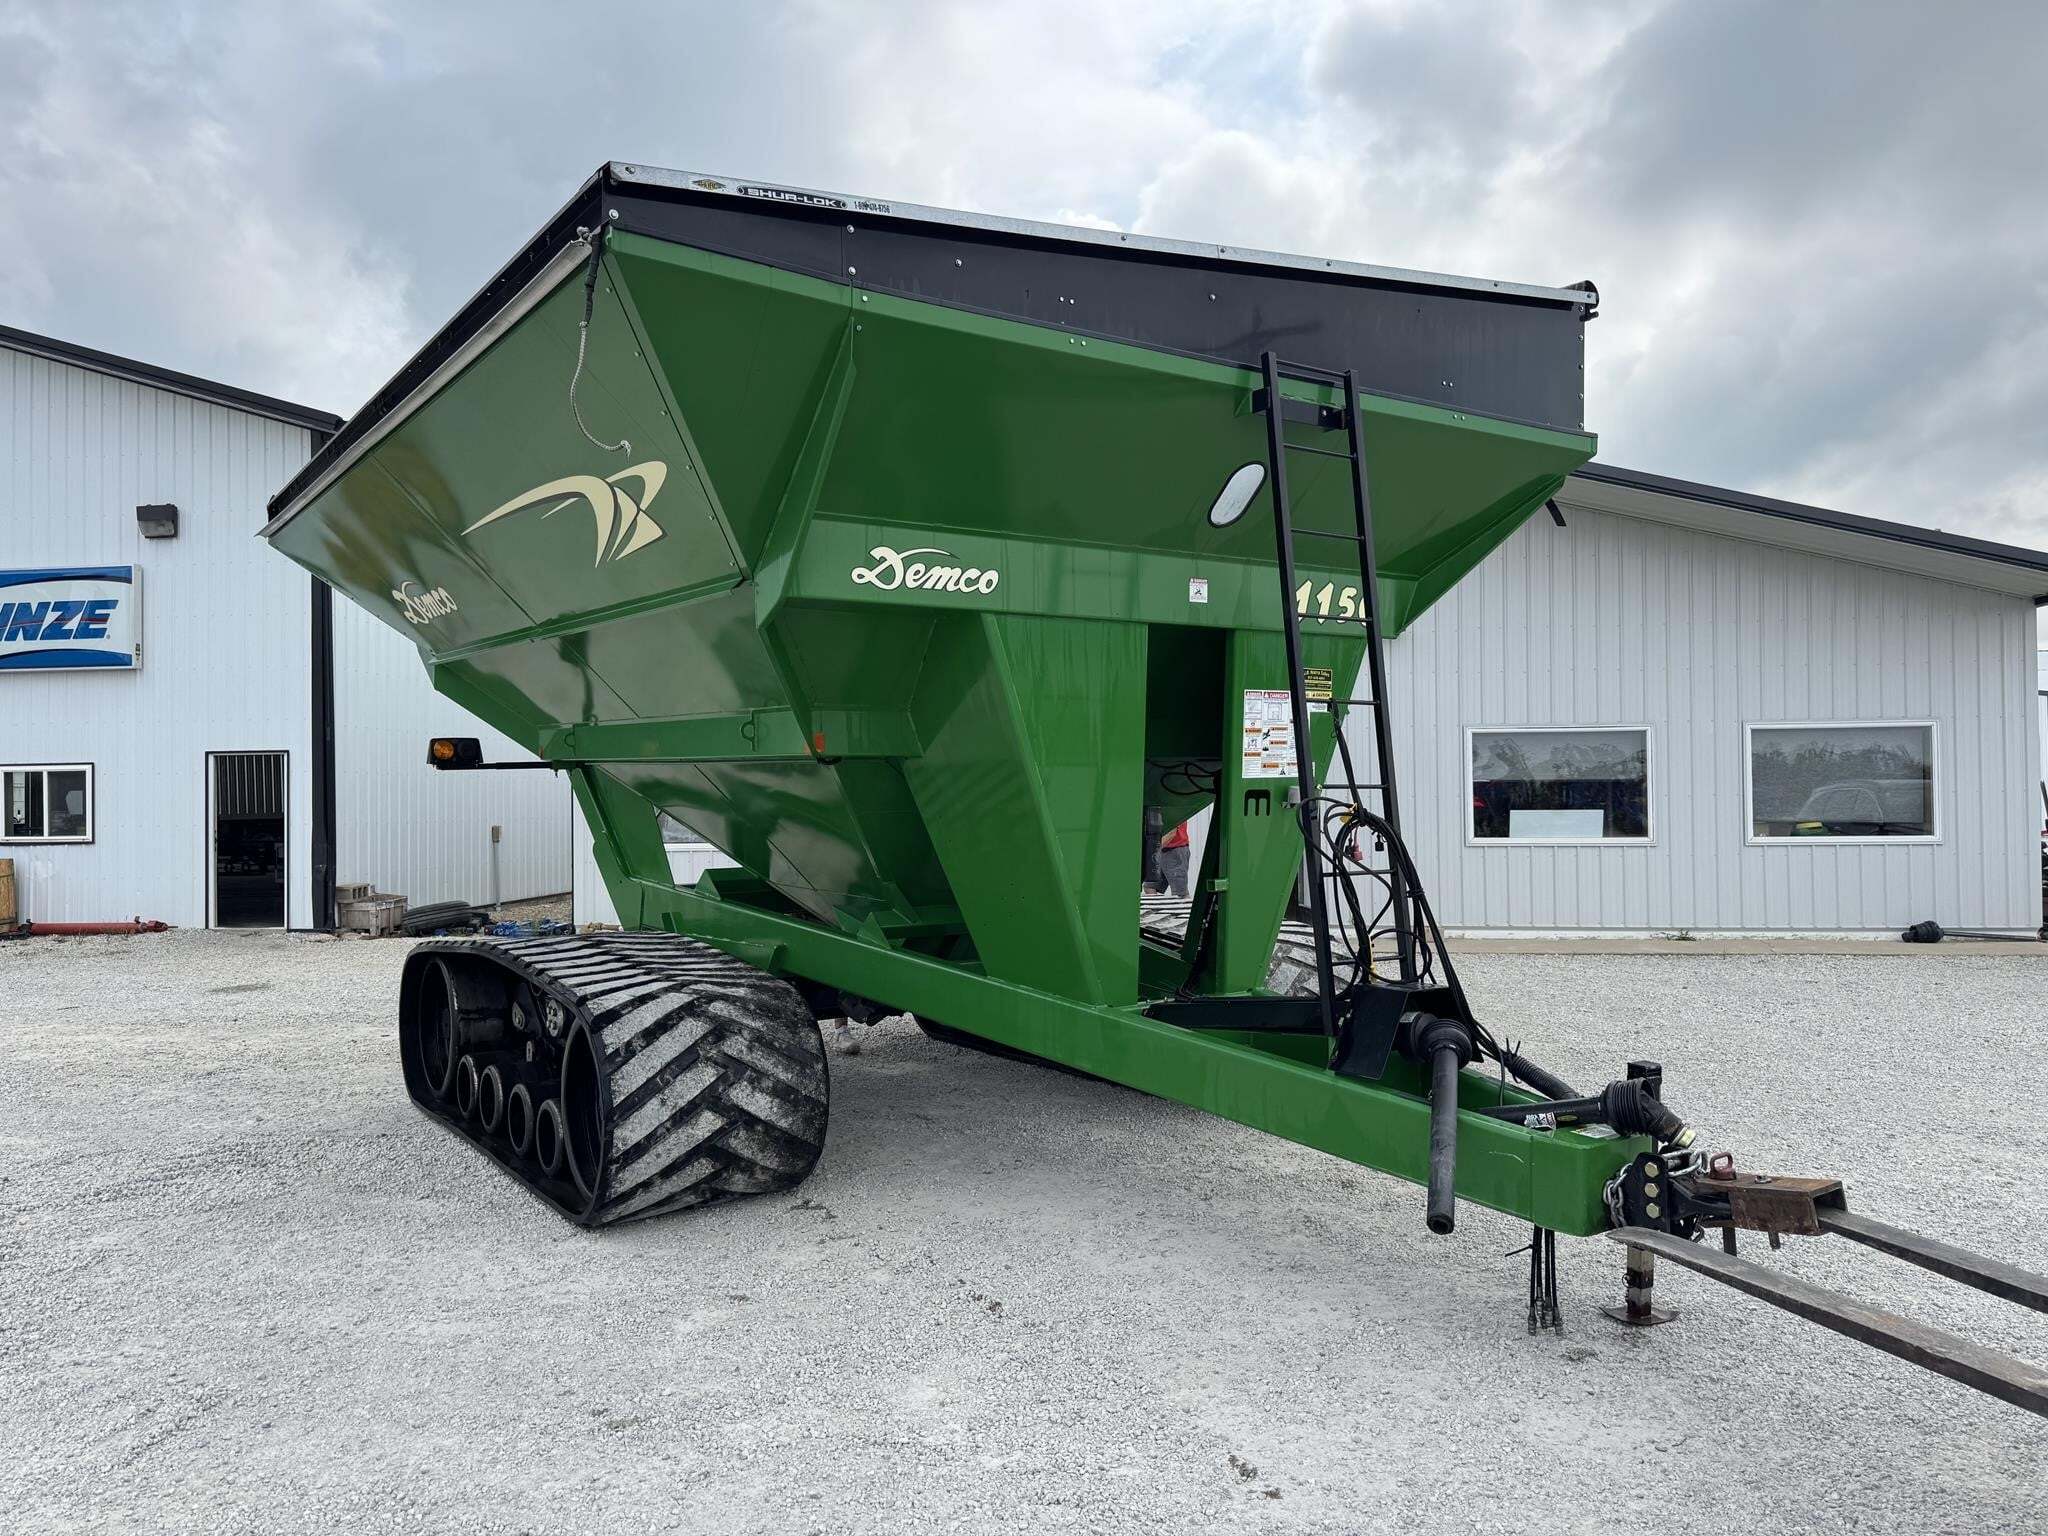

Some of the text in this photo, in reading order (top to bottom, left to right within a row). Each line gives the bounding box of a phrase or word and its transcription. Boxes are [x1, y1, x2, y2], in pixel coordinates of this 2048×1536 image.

[747, 188, 838, 208] SHUR-LOK
[850, 546, 1000, 595] Demco
[0, 599, 120, 642] INZE
[391, 581, 459, 625] Demco
